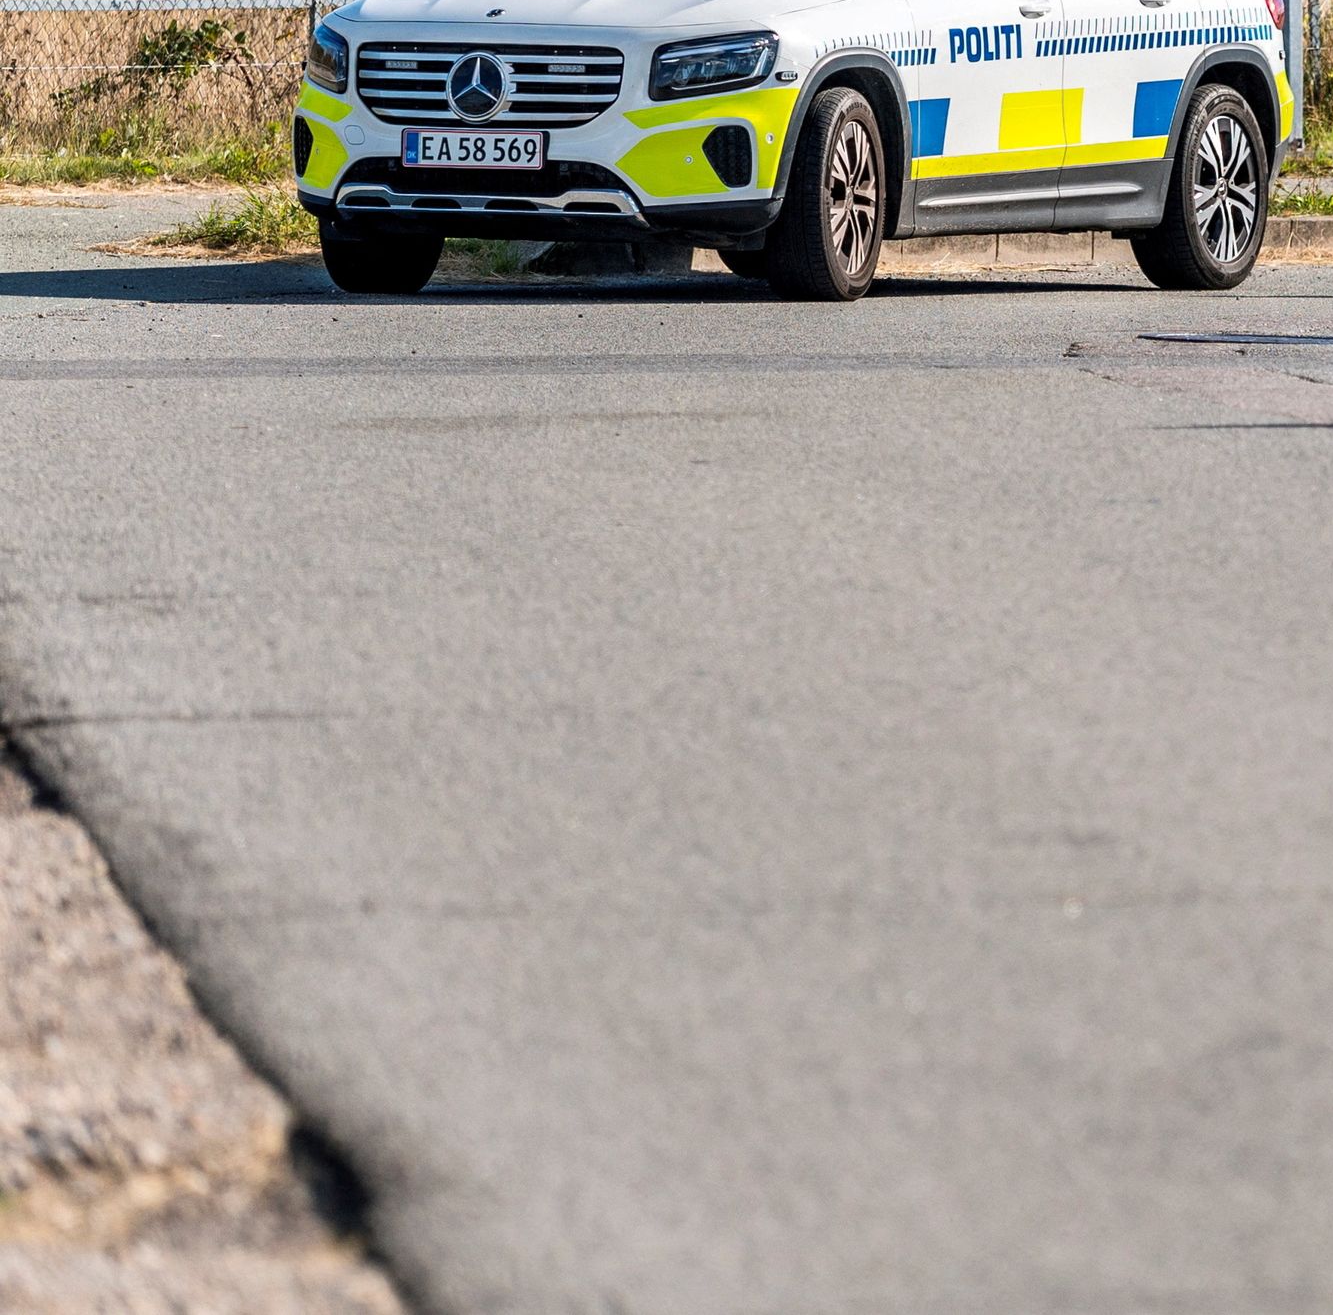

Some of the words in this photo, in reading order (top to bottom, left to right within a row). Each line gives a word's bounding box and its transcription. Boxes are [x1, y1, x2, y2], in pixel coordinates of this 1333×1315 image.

[949, 24, 1023, 64] POLITI
[407, 151, 417, 159] DK
[421, 136, 451, 161] EA
[458, 137, 486, 162] 58
[492, 138, 537, 164] 569
